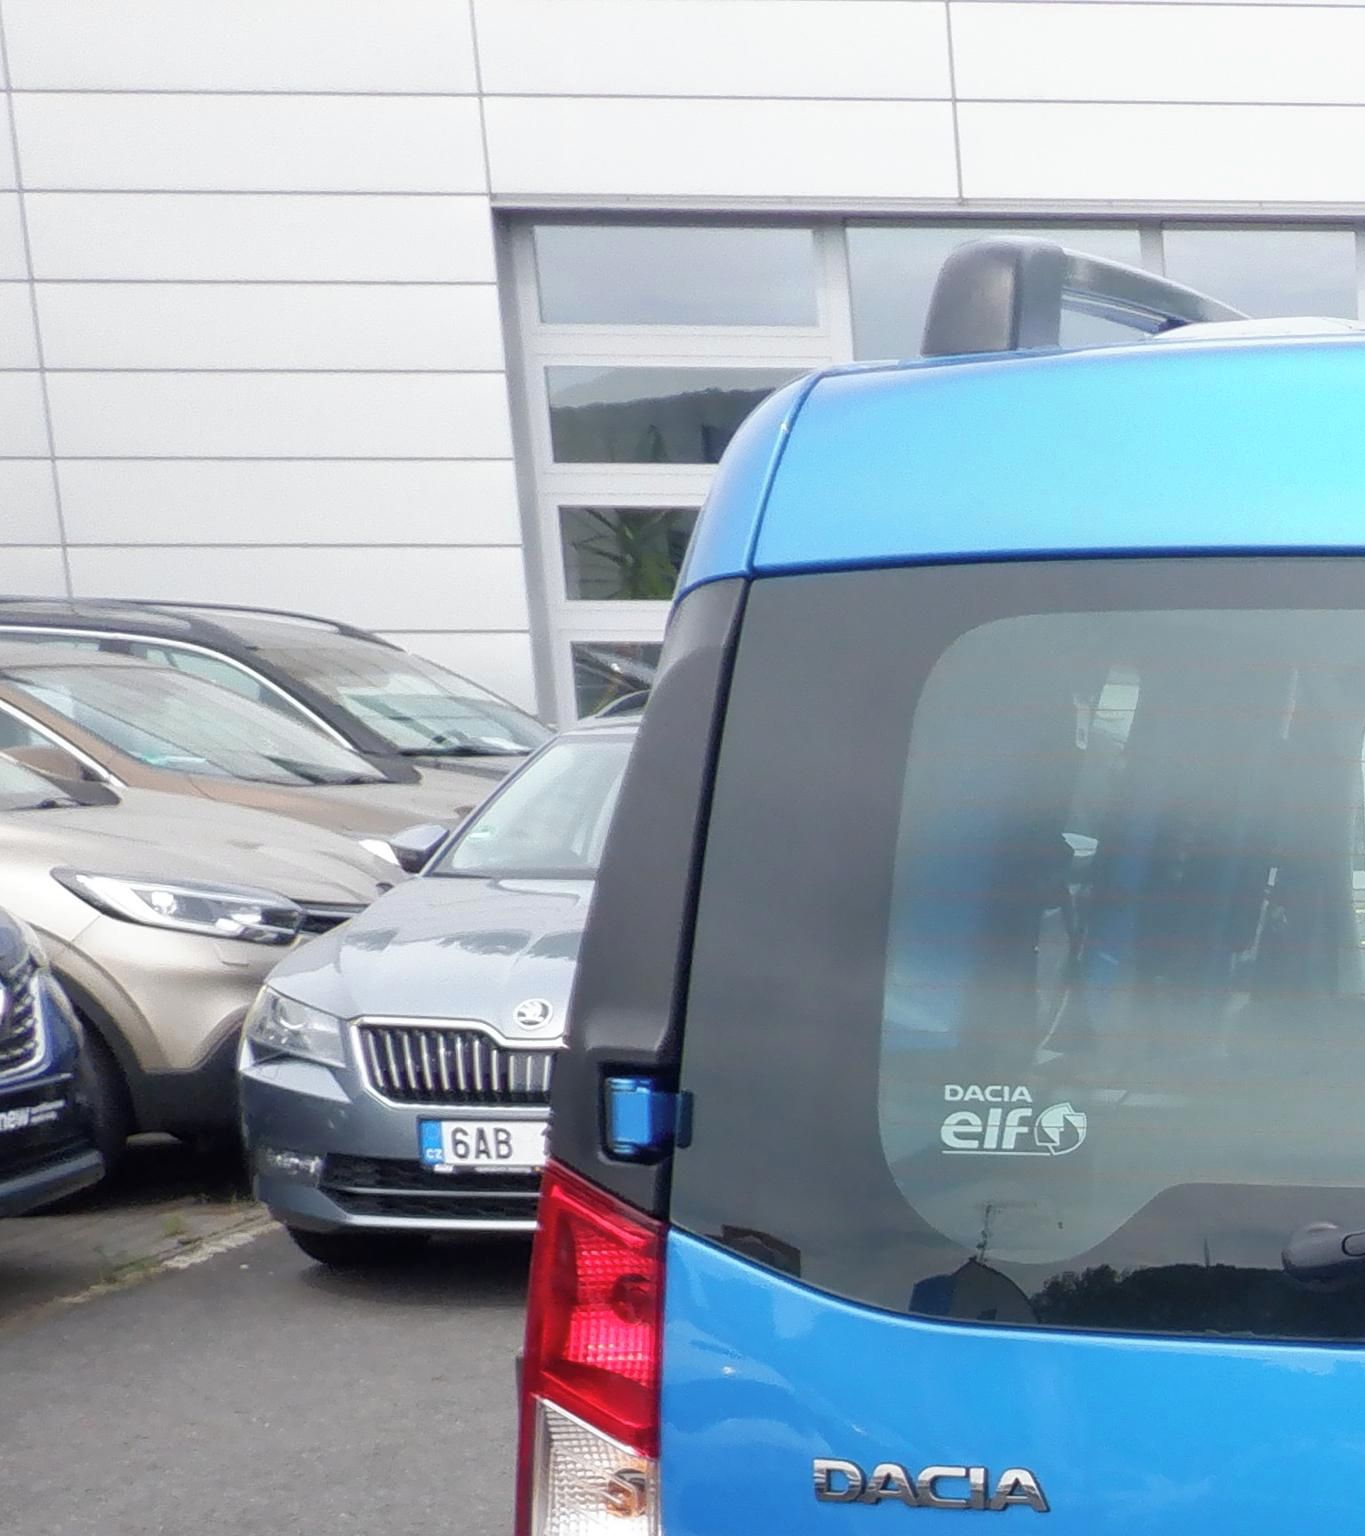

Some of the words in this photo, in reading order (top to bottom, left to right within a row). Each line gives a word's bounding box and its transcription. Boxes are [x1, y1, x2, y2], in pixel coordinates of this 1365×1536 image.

[944, 1084, 1033, 1103] DACIA
[450, 1126, 514, 1160] 6AB
[940, 1107, 1033, 1150] elf
[812, 1457, 1051, 1513] DACIA
